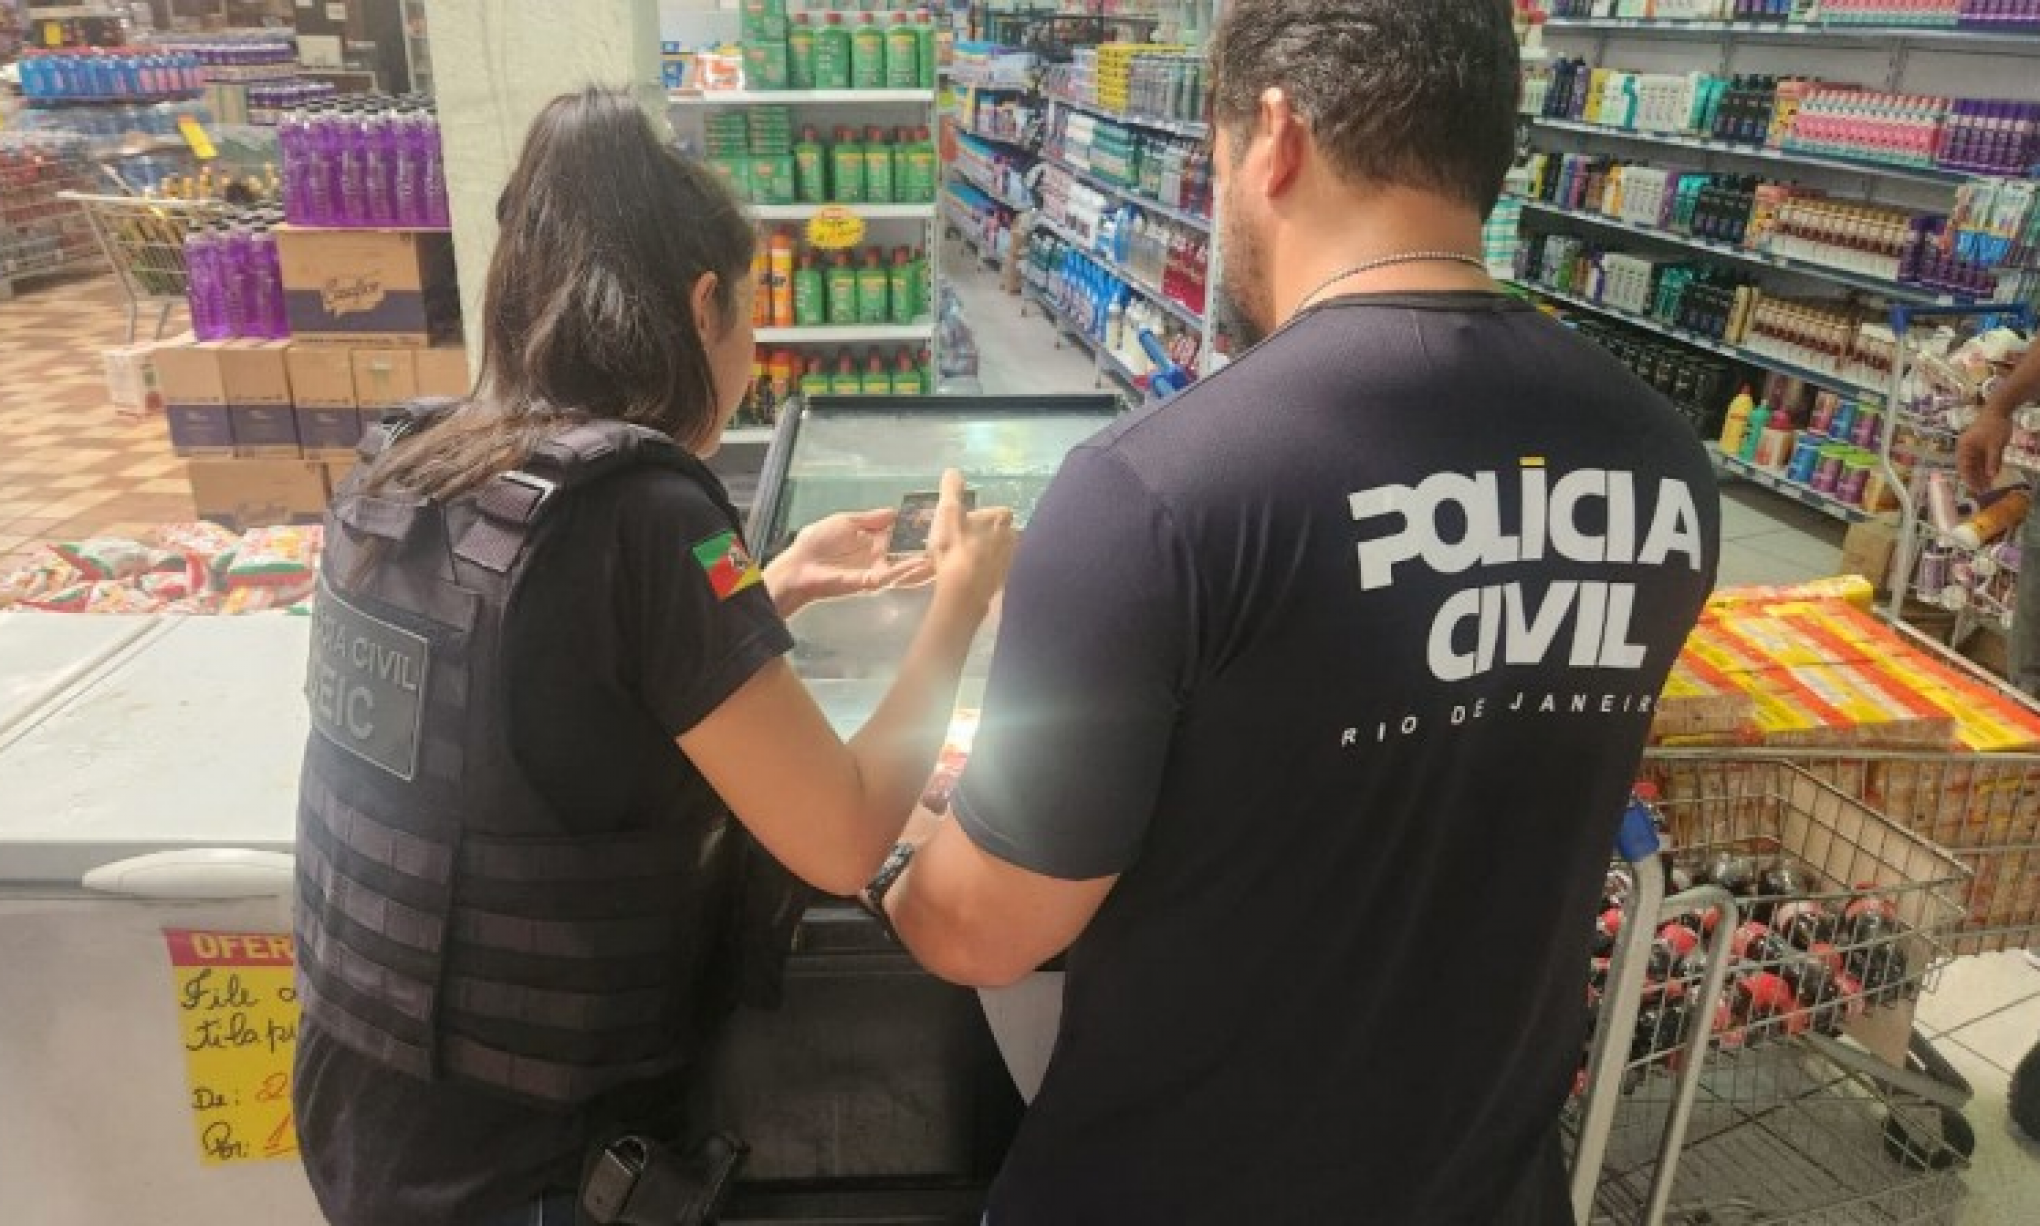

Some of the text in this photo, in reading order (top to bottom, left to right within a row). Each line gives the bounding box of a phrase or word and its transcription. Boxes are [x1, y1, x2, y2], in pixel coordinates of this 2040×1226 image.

[1427, 580, 1647, 682] CIVIL
[352, 636, 418, 691] CIVIL
[1341, 692, 1658, 746] RIO DE JANEIR
[192, 935, 295, 960] OFER
